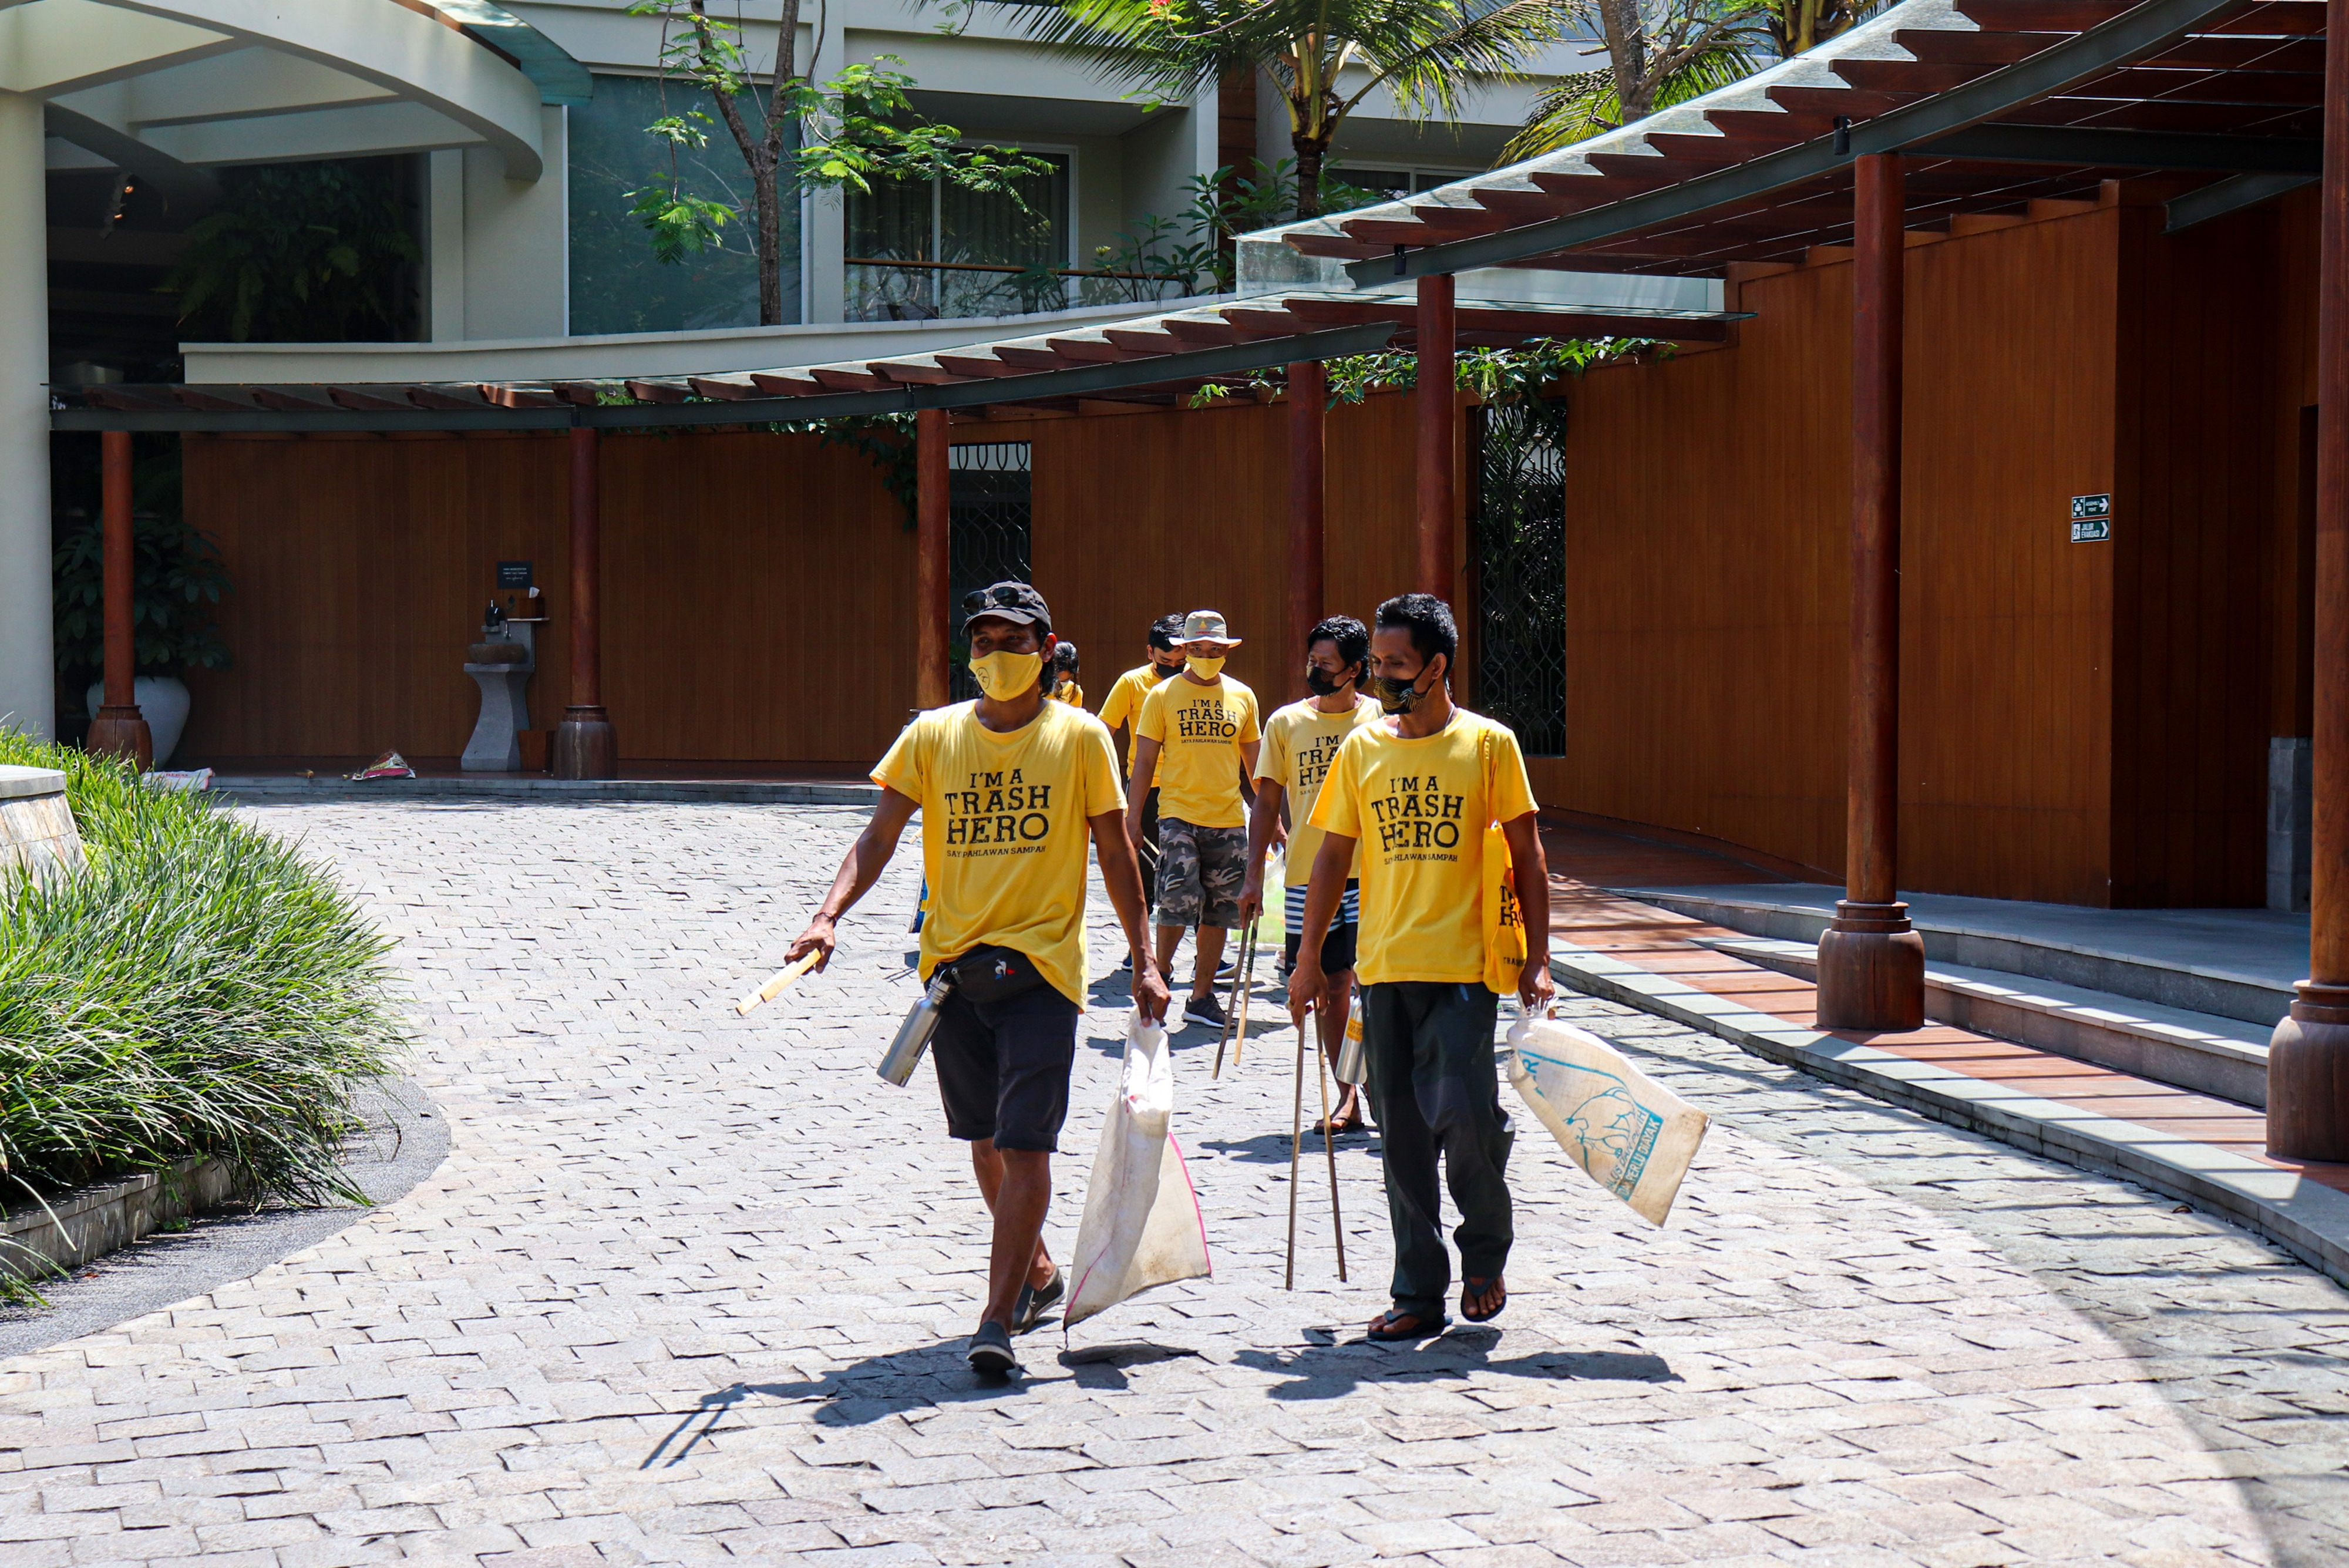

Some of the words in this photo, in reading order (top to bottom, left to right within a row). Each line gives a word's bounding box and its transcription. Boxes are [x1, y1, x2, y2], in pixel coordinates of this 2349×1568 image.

[1193, 699, 1210, 707] I'M
[1177, 708, 1237, 723] TRASH
[1179, 721, 1236, 738] HERO
[1315, 735, 1340, 747] I'M
[1296, 746, 1340, 766] TRA
[970, 771, 1004, 788] I'M
[1009, 768, 1024, 785] A
[1299, 764, 1330, 786] HE
[1390, 776, 1419, 793] I'M
[1425, 776, 1439, 791] A
[944, 785, 1051, 815] TRASH
[1371, 794, 1464, 823] TRASH
[947, 813, 1049, 844] HERO
[1379, 821, 1459, 852] HERO
[963, 848, 1009, 858] PAHLAWAN
[1011, 846, 1046, 854] SAMPAH
[1427, 853, 1458, 862] SAMPAH
[1625, 1152, 1645, 1185] PERLU
